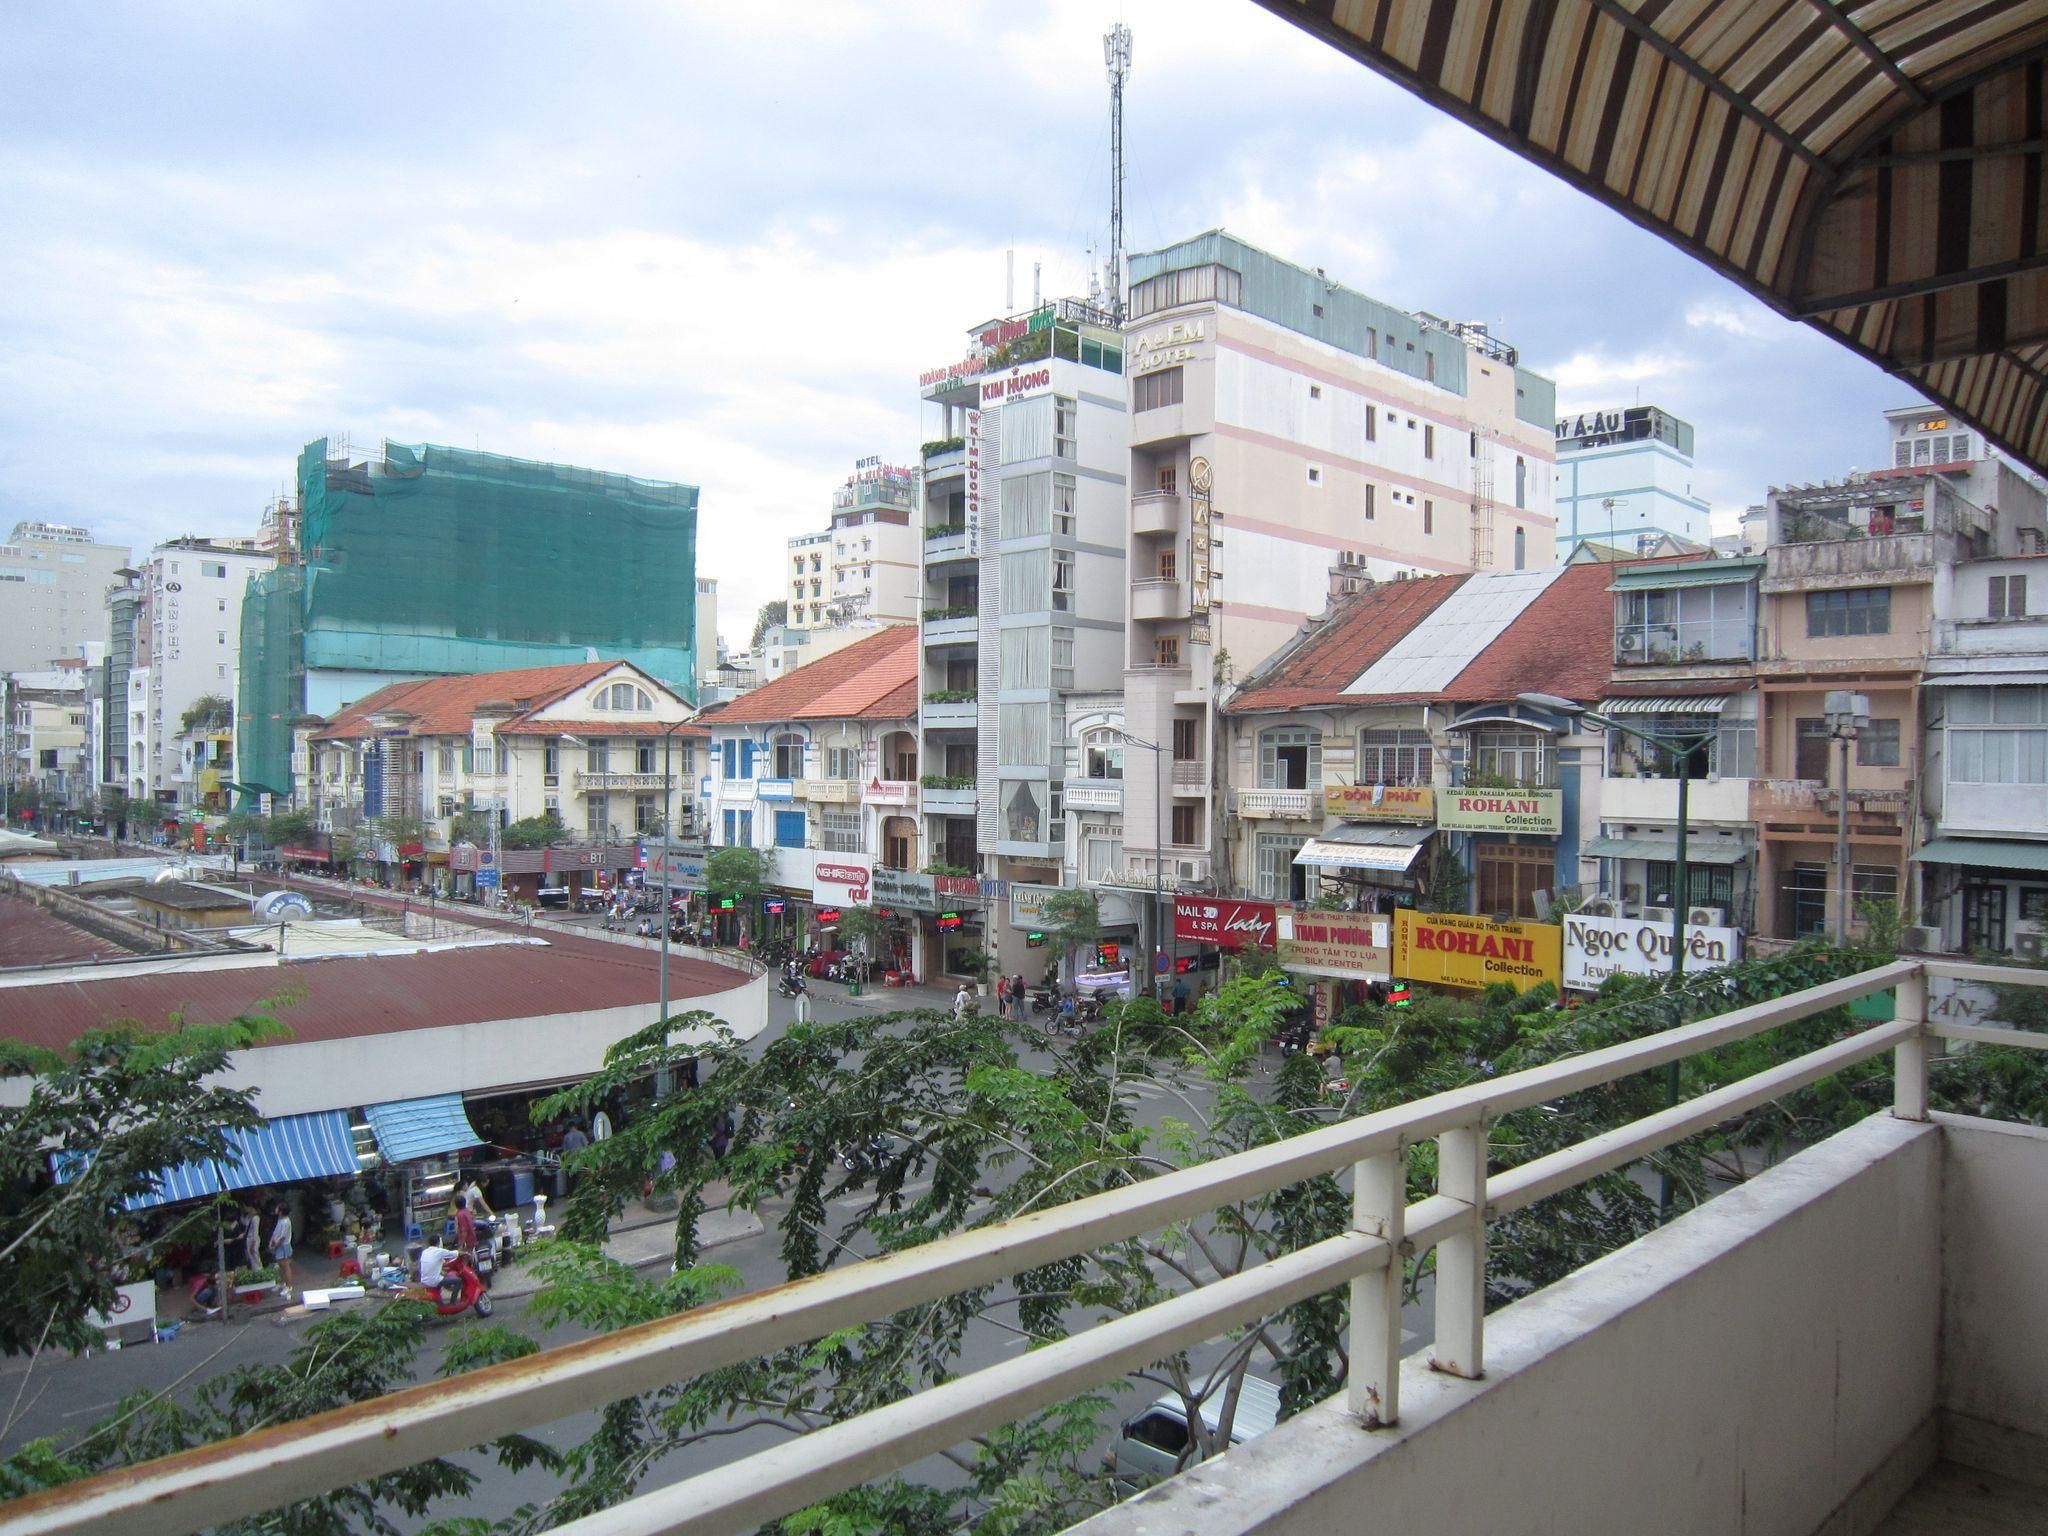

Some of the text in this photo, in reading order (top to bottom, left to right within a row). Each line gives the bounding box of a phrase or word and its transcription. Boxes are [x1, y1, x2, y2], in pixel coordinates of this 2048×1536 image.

[1140, 347, 1198, 371] HOTEL
[982, 369, 1050, 401] KIM HUONG
[969, 426, 979, 456] KIM
[856, 455, 881, 470] HOTEL
[969, 460, 978, 513] HUONG
[1458, 798, 1540, 814] ROHANI
[1504, 815, 1552, 825] Collection
[1177, 905, 1202, 918] NAIL
[1191, 920, 1218, 931] & SPA
[1295, 924, 1327, 943] THANH
[1501, 924, 1523, 935] TRANG
[1401, 920, 1409, 961] ROHANI
[1416, 927, 1535, 963] ROHANI
[1567, 921, 1725, 962] Ngọc Quyên
[1292, 945, 1319, 955] TRUNG
[1305, 957, 1363, 969] SILK CENTER
[1485, 959, 1543, 977] Collection
